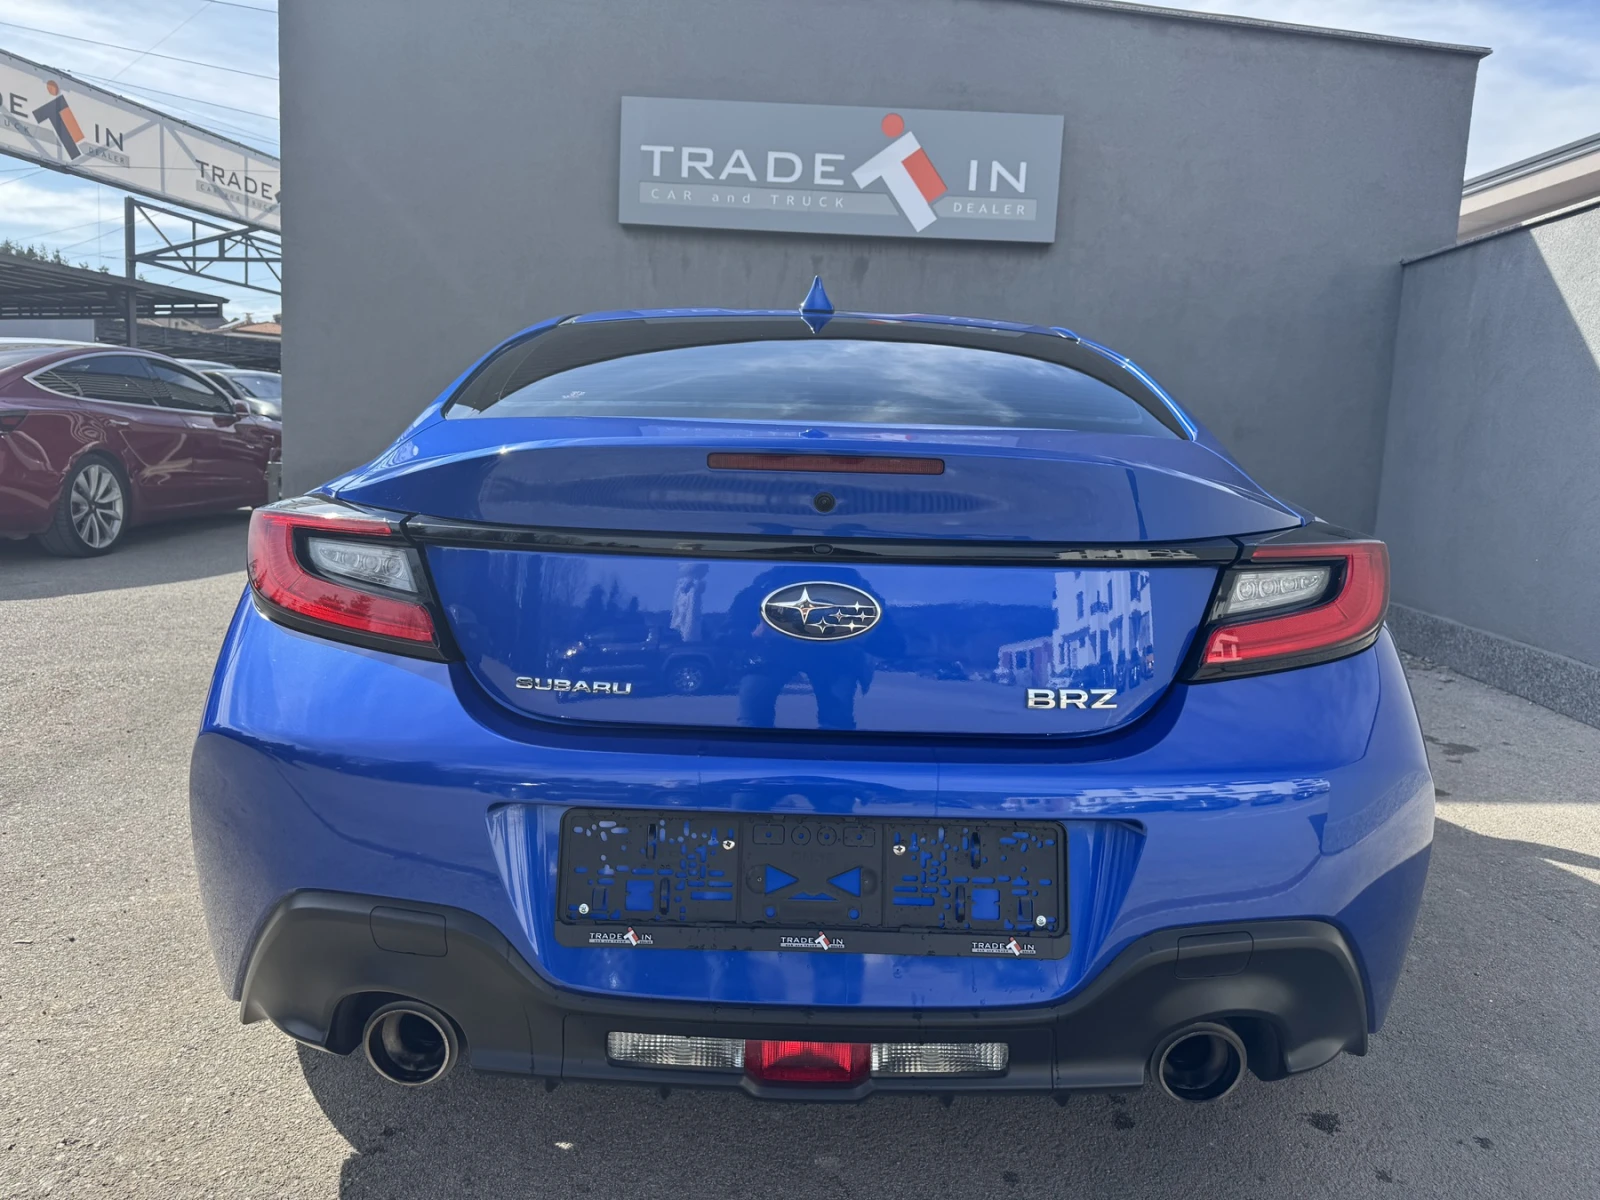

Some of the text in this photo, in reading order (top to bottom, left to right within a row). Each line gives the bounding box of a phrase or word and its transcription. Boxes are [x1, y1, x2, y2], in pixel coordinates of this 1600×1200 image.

[0, 91, 124, 151] E IN
[88, 146, 125, 163] DEALER
[640, 144, 845, 186] TRADE
[968, 159, 1028, 193] IN
[195, 159, 273, 200] TRADE
[651, 188, 1026, 216] CAR and TRUCK DEALER
[515, 676, 632, 695] SUBARU
[1027, 688, 1118, 709] BRZ
[589, 932, 623, 940] TRADE
[781, 936, 815, 944] TRADE
[972, 942, 1006, 950] TRADE
